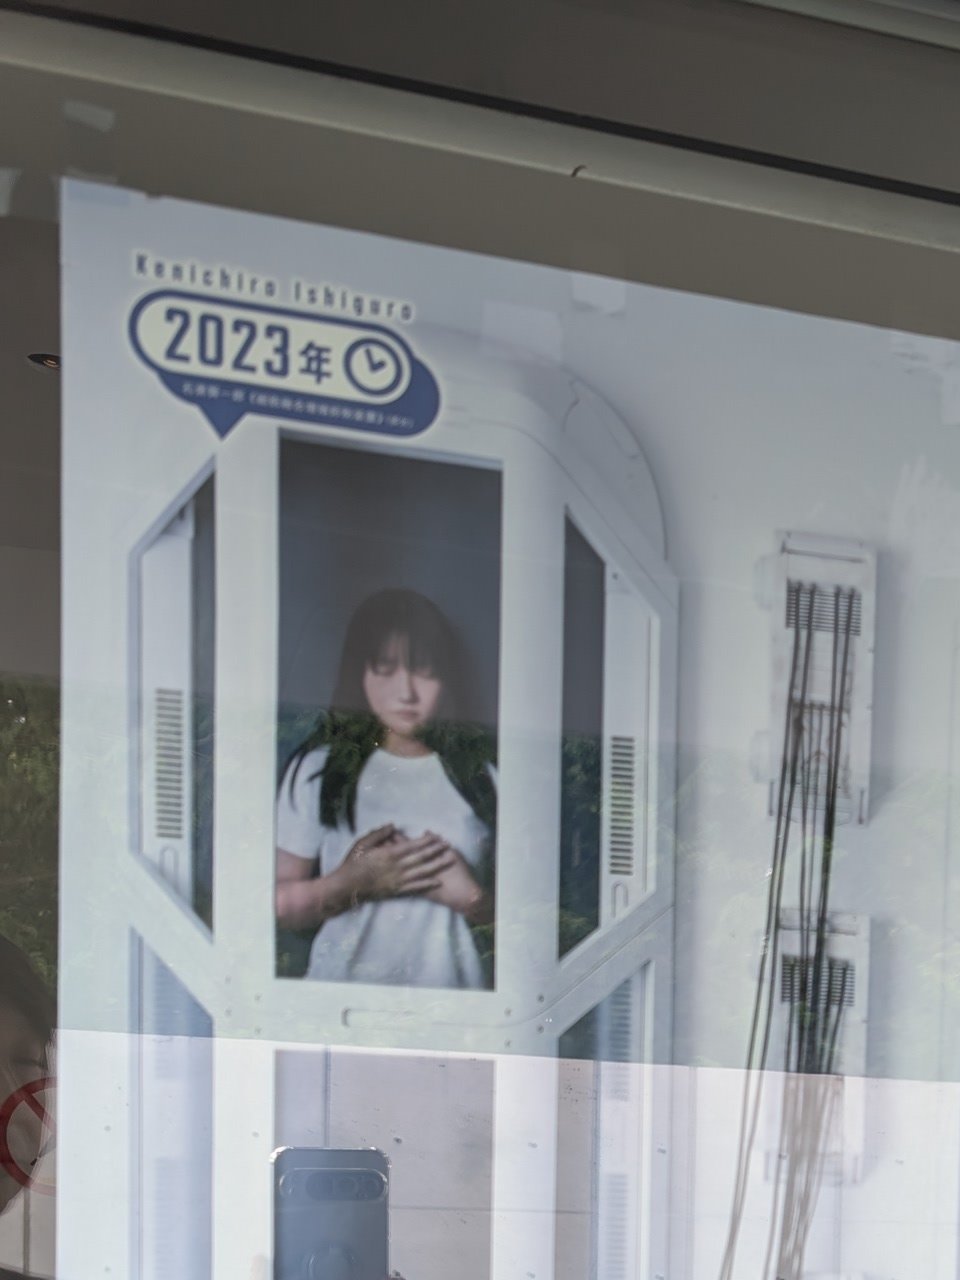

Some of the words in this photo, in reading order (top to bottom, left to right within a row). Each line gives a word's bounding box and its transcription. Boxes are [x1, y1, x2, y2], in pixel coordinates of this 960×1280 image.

[137, 254, 274, 297] Kenichiro
[295, 282, 413, 321] Ishiguro
[164, 307, 333, 385] 2023年
